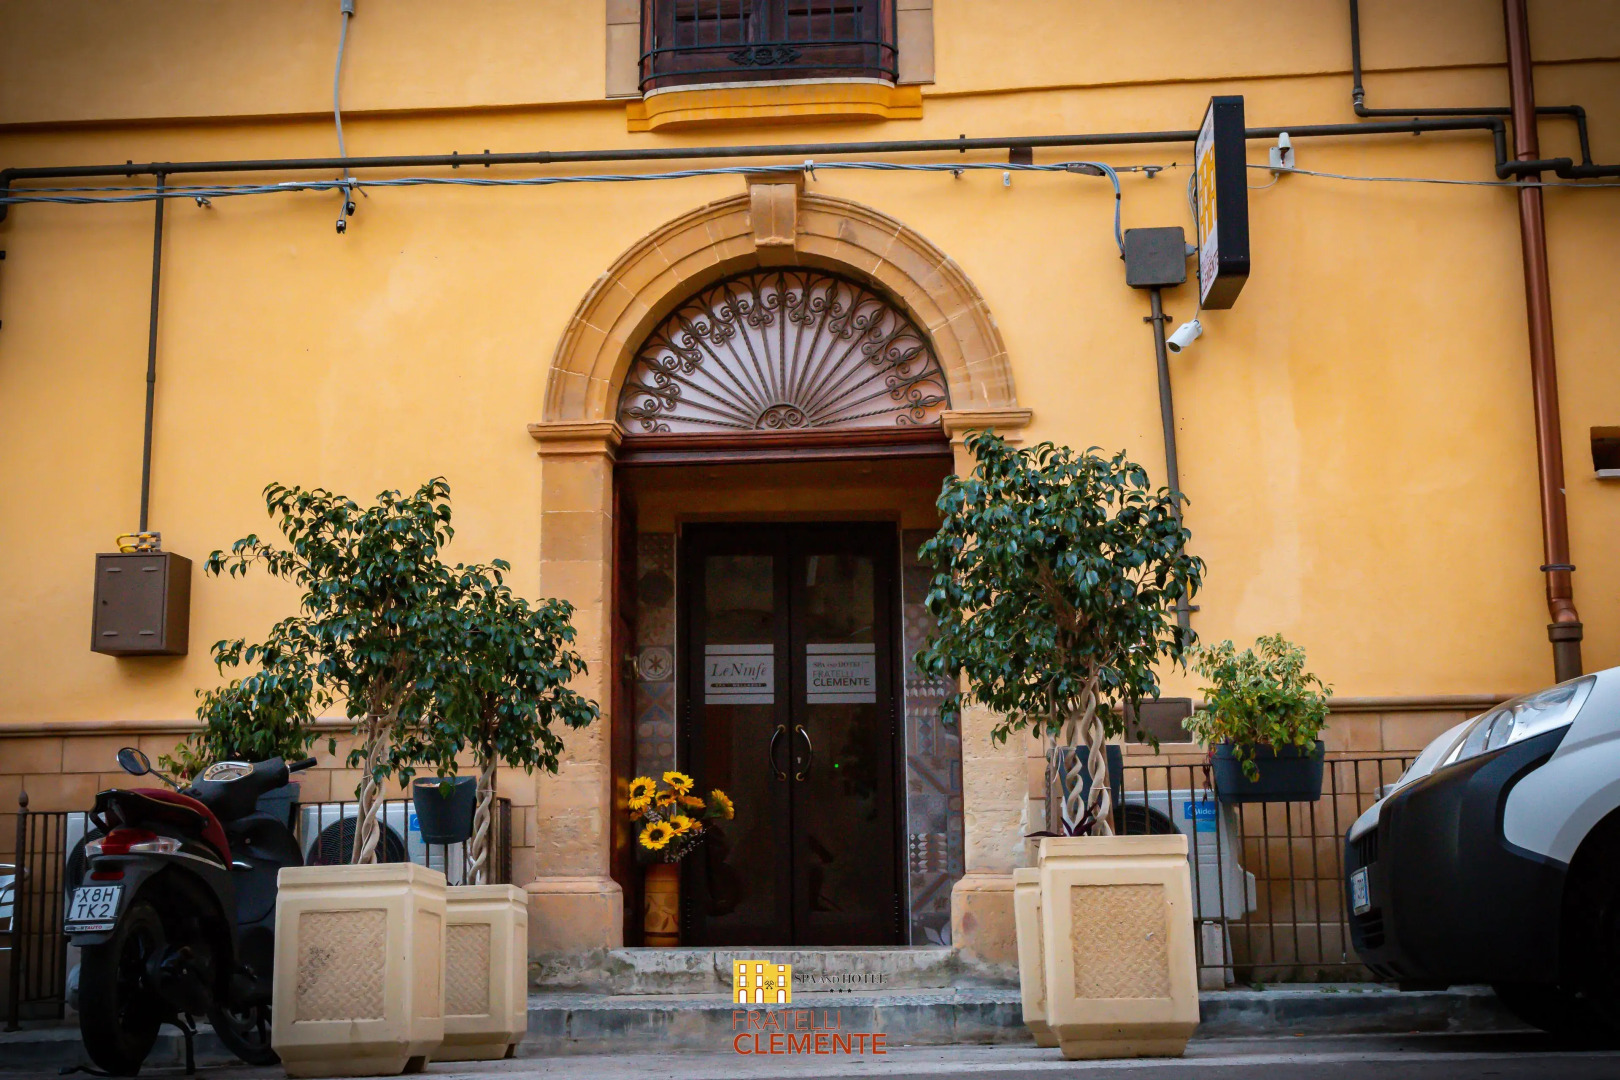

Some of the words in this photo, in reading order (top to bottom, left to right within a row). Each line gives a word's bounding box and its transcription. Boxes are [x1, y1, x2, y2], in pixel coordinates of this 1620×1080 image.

[812, 670, 854, 678] FRATELLI
[813, 677, 870, 687] CLEMENTE
[79, 888, 114, 902] X8H
[78, 904, 110, 919] TK2
